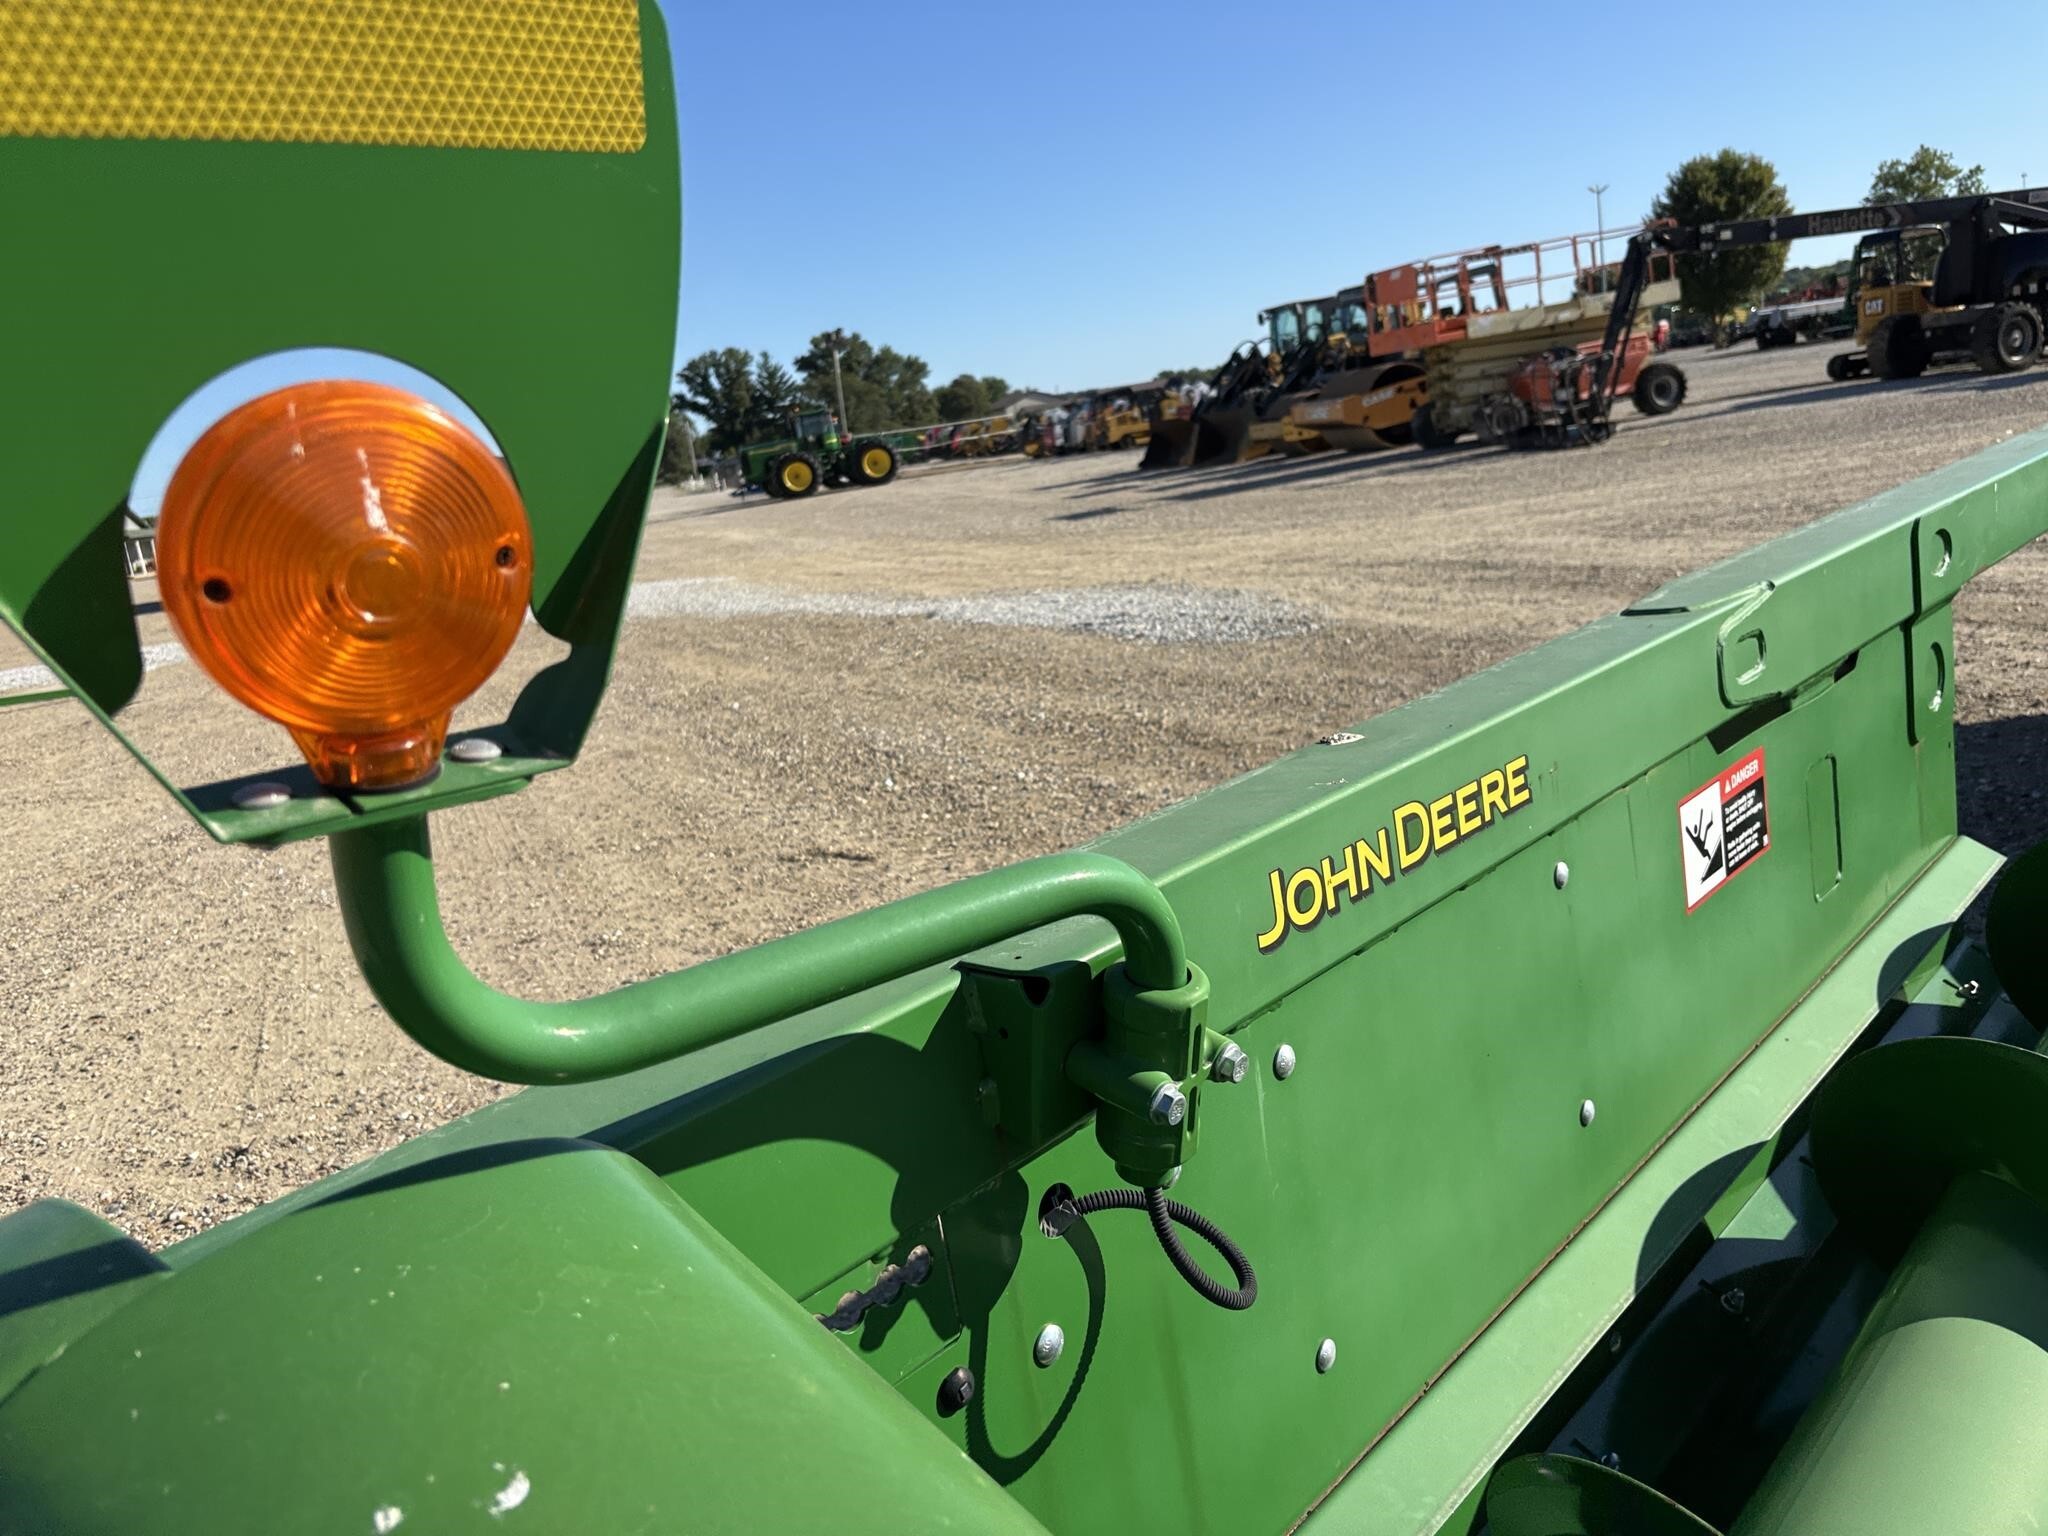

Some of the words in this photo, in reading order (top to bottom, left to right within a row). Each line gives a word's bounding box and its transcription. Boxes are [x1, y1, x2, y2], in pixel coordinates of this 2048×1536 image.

[1864, 299, 1883, 316] CAT
[1731, 759, 1759, 789] DANGER
[1257, 828, 1393, 953] JOHN
[1393, 754, 1533, 876] DEERE
